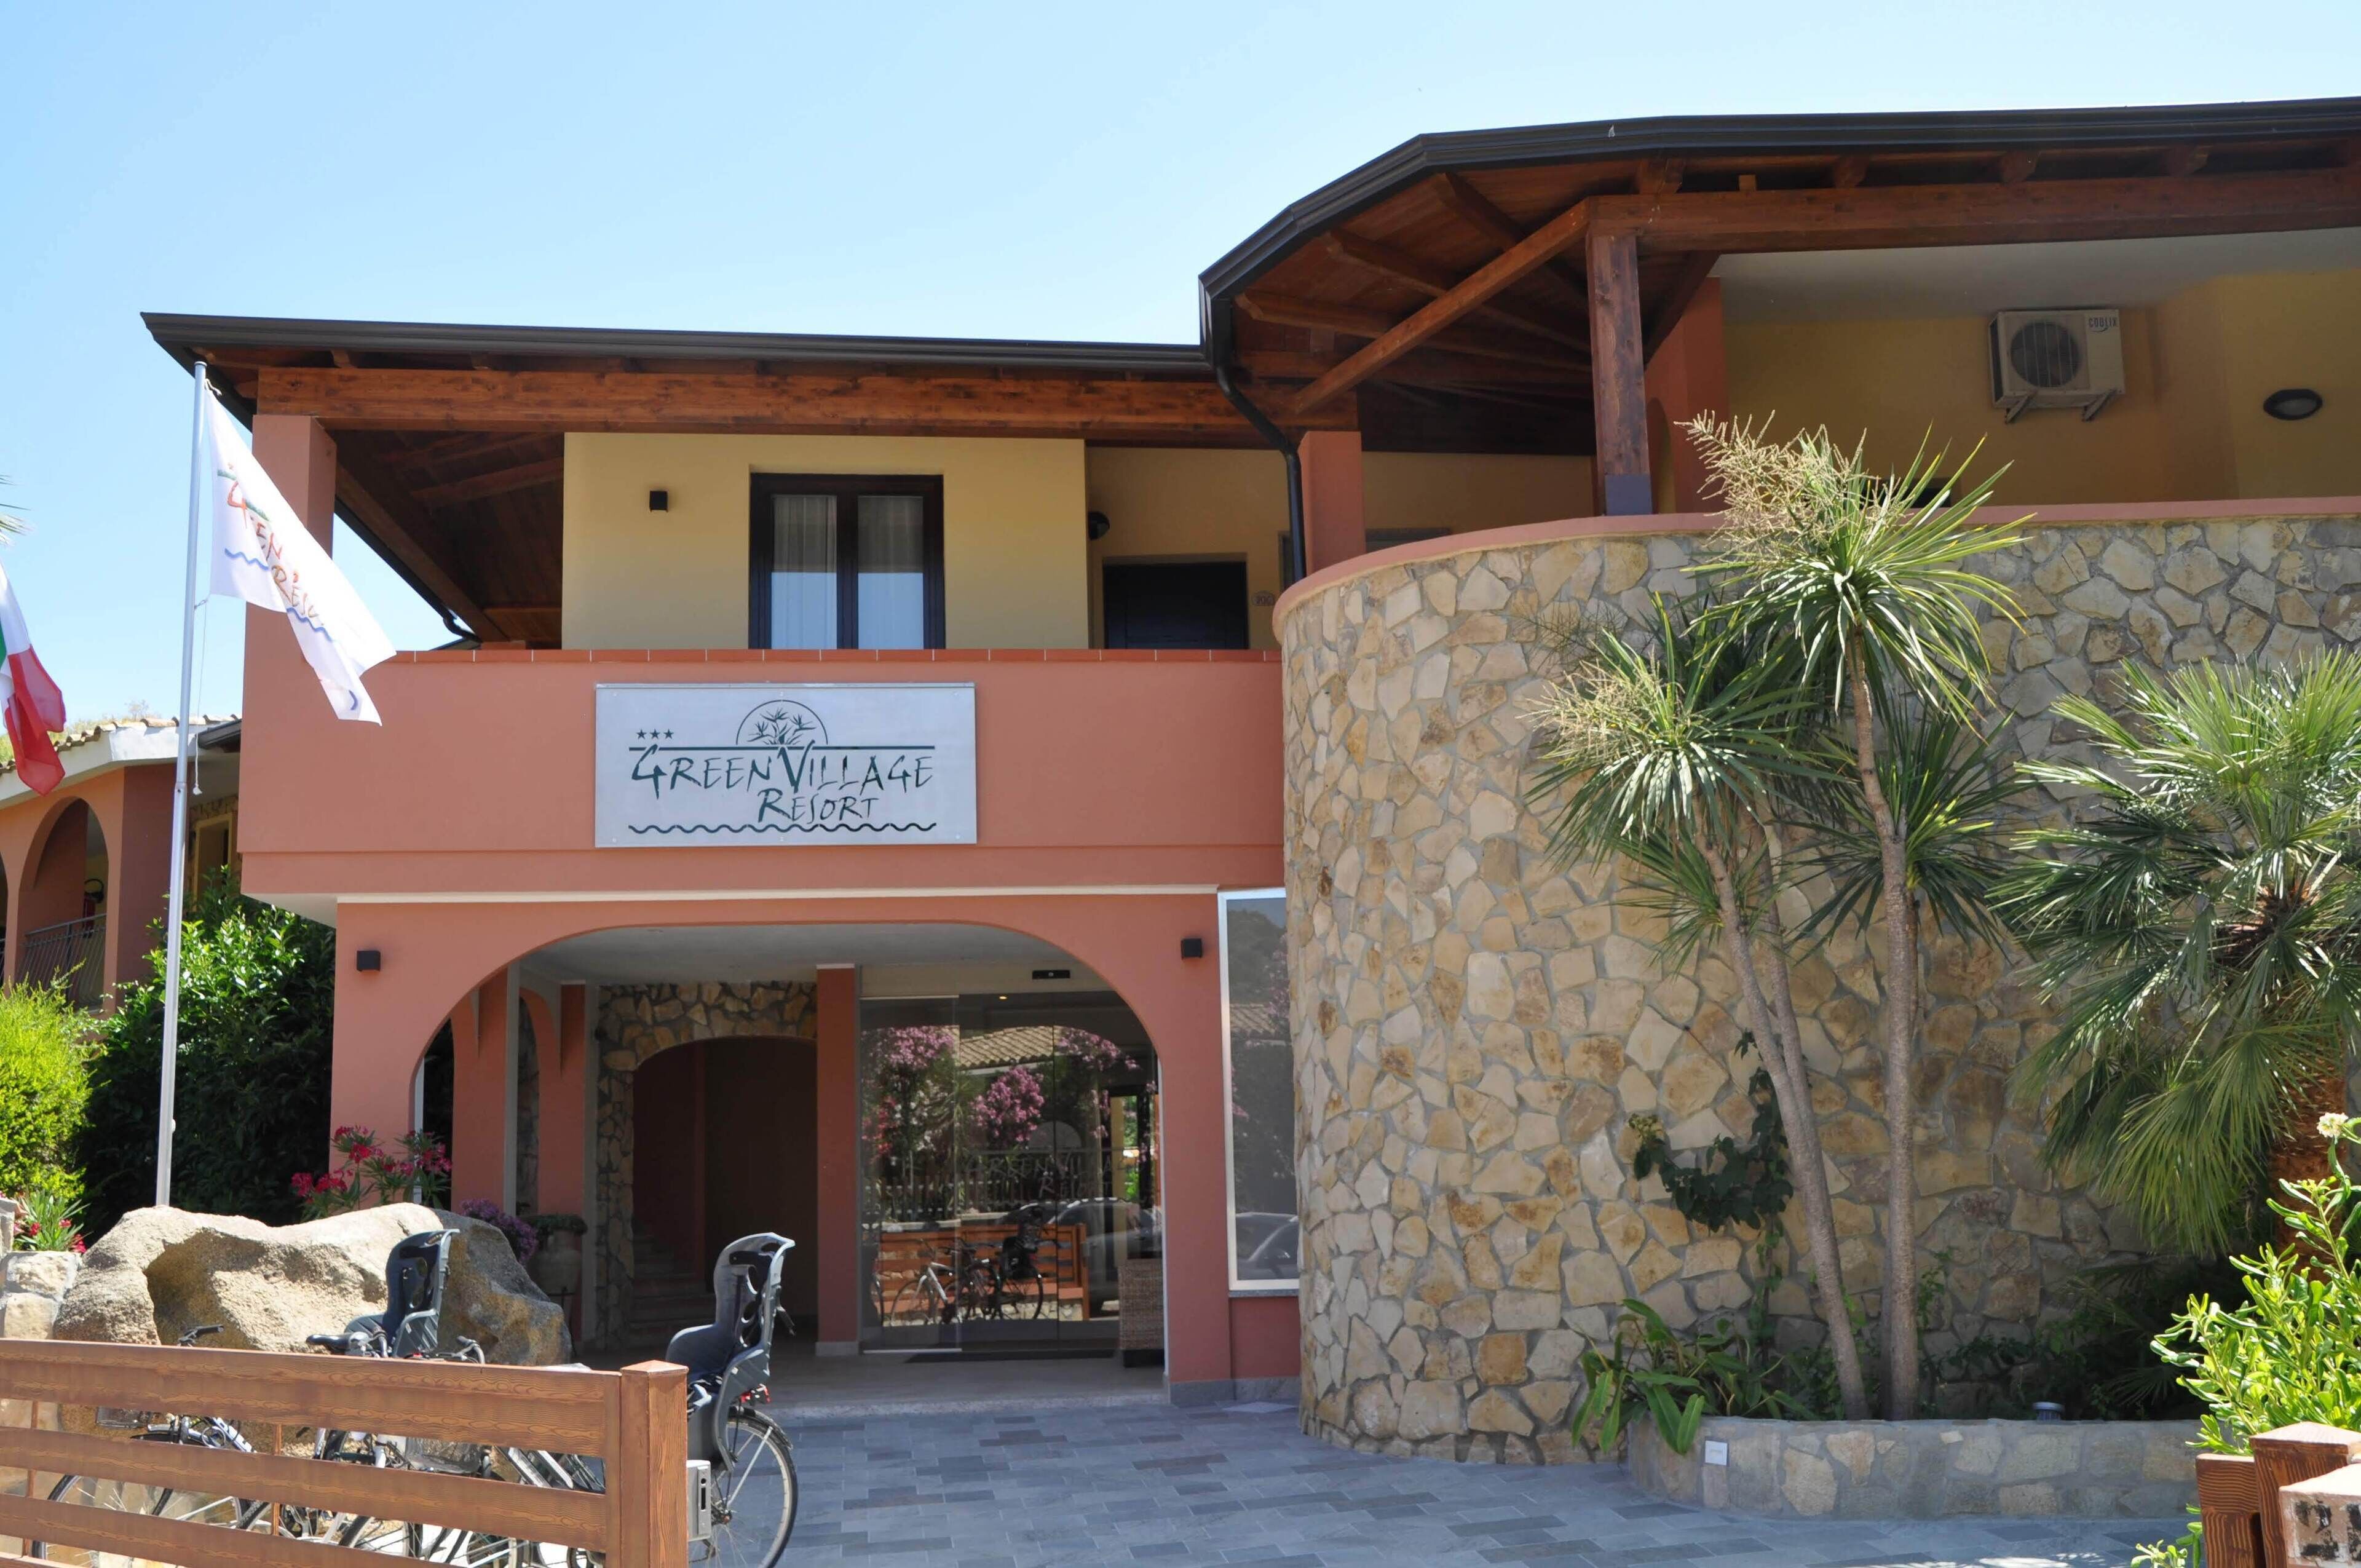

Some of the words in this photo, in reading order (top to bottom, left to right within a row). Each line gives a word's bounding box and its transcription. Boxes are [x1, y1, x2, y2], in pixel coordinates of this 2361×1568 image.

[631, 744, 772, 799] GREEN
[777, 740, 933, 796] VILLAGE
[757, 788, 879, 825] RESORT
